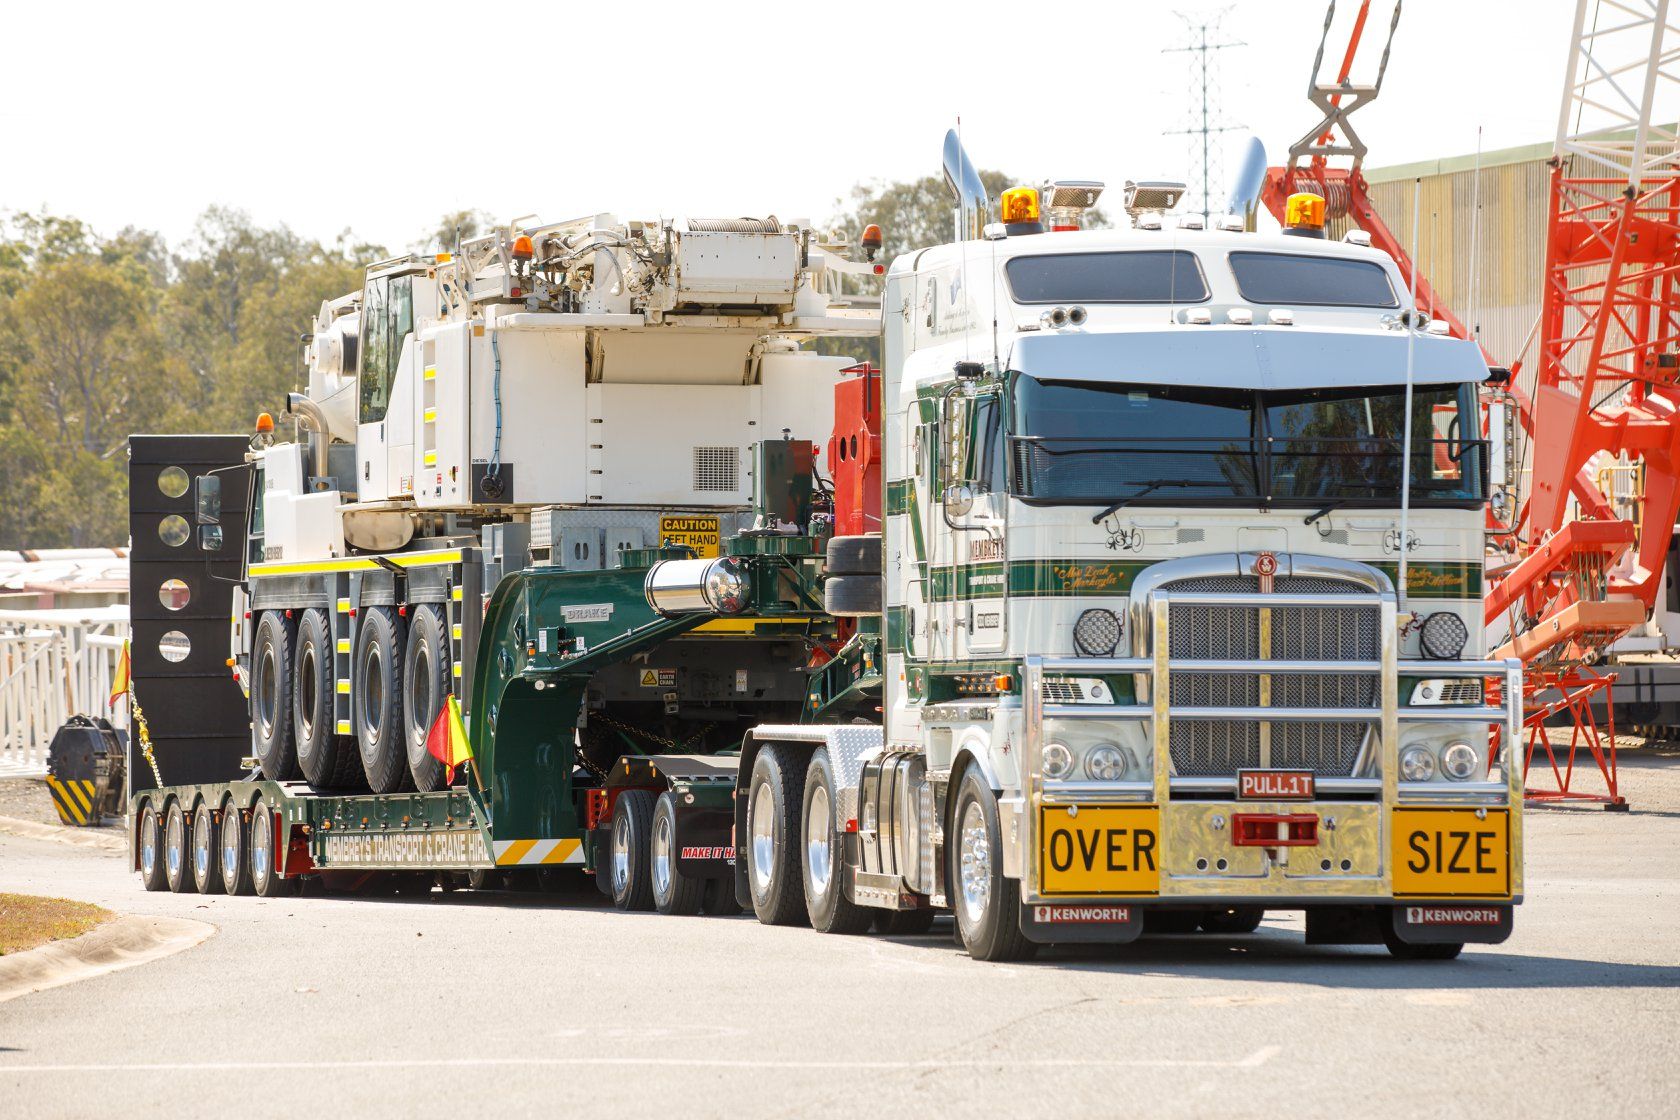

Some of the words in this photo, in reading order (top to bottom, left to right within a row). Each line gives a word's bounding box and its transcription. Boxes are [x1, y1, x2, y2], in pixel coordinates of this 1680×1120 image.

[663, 520, 716, 530] CAUTION
[663, 535, 687, 545] LEFT
[689, 535, 717, 545] HAND
[567, 608, 608, 620] DRAKE
[373, 834, 423, 862] TRANSPORT
[426, 834, 433, 862] &
[435, 834, 466, 862] CRANE
[681, 847, 712, 859] MAKE
[712, 847, 724, 859] IT
[1050, 828, 1156, 872] OVER
[1408, 830, 1497, 874] SIZE
[1052, 908, 1128, 920] KENWORTH
[1425, 910, 1498, 922] KENWORTH
